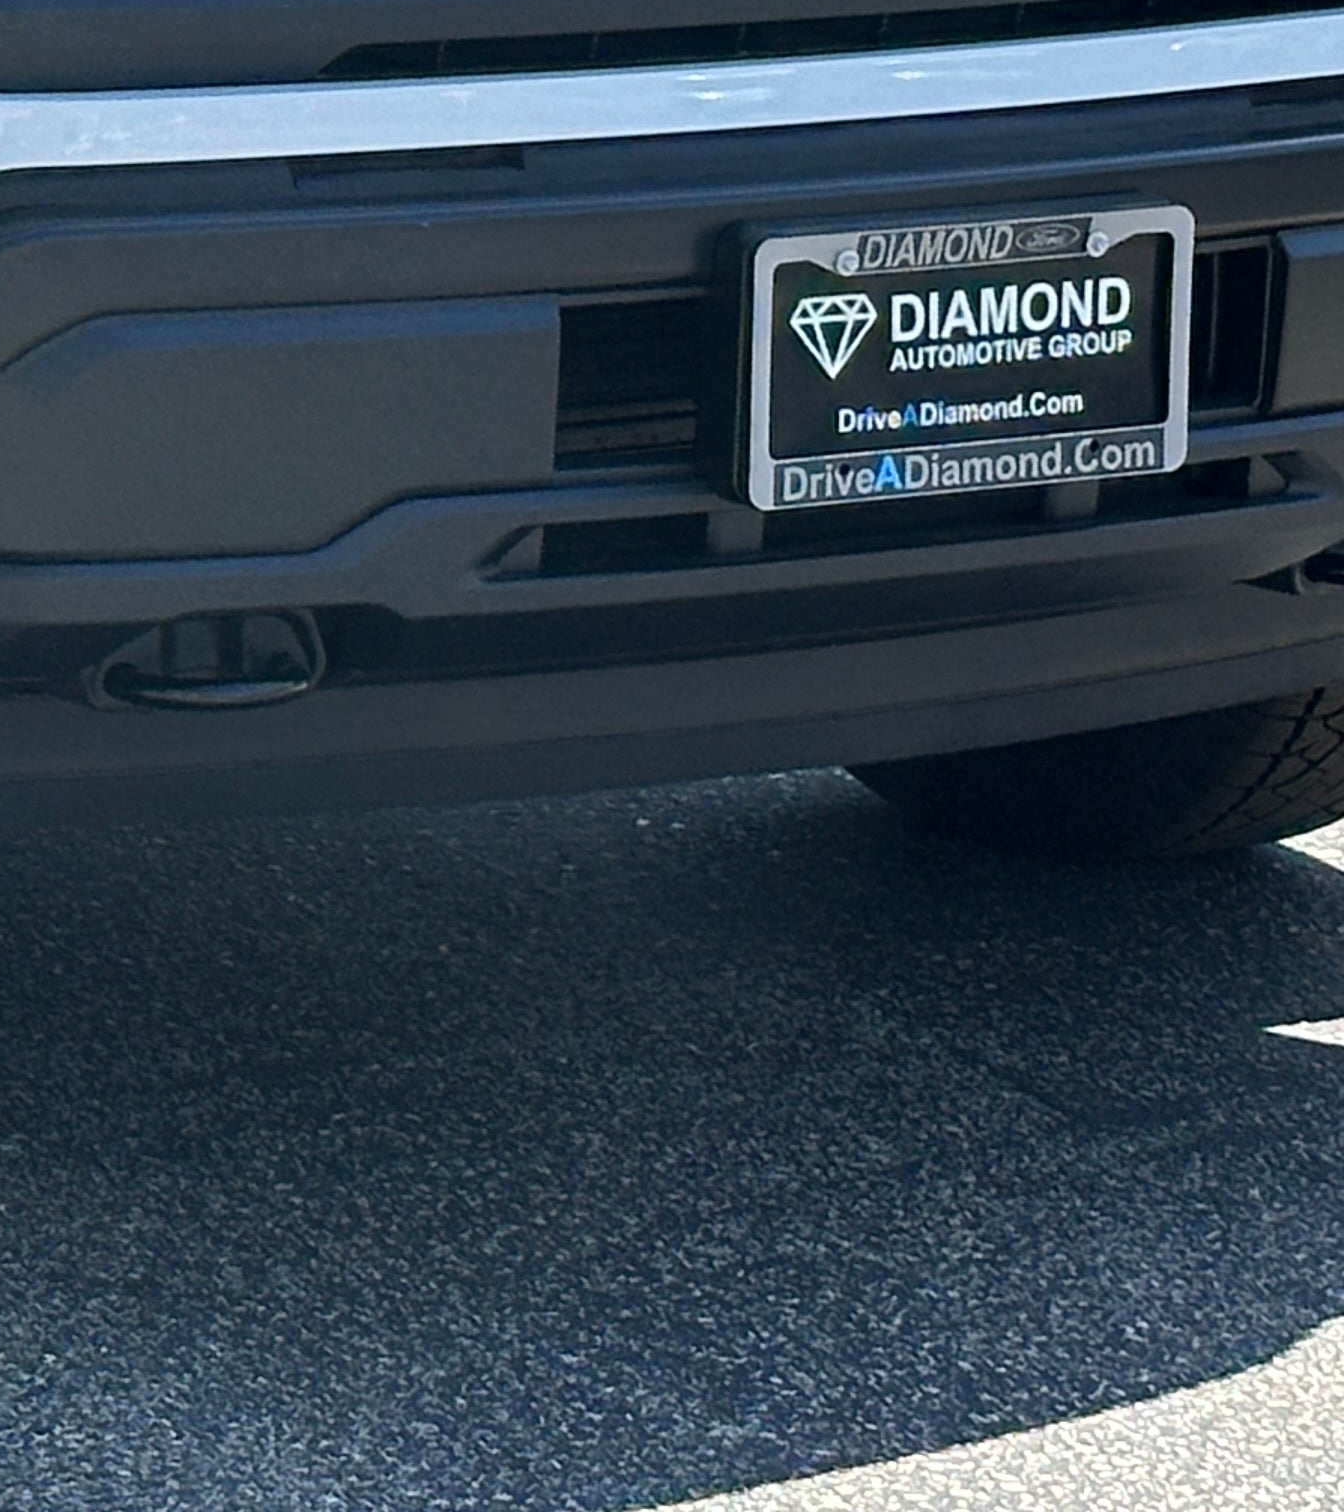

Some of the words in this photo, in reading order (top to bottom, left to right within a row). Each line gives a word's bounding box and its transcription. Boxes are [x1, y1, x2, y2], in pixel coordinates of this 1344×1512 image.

[862, 224, 1014, 271] DIAMOND
[890, 276, 1132, 343] DIAMOND
[889, 337, 1043, 373] AUTOMOTIVE
[1049, 329, 1133, 360] GROUP
[837, 391, 1085, 435] DriveADiamond.Com
[782, 439, 1156, 502] DriveADiamond.Com
